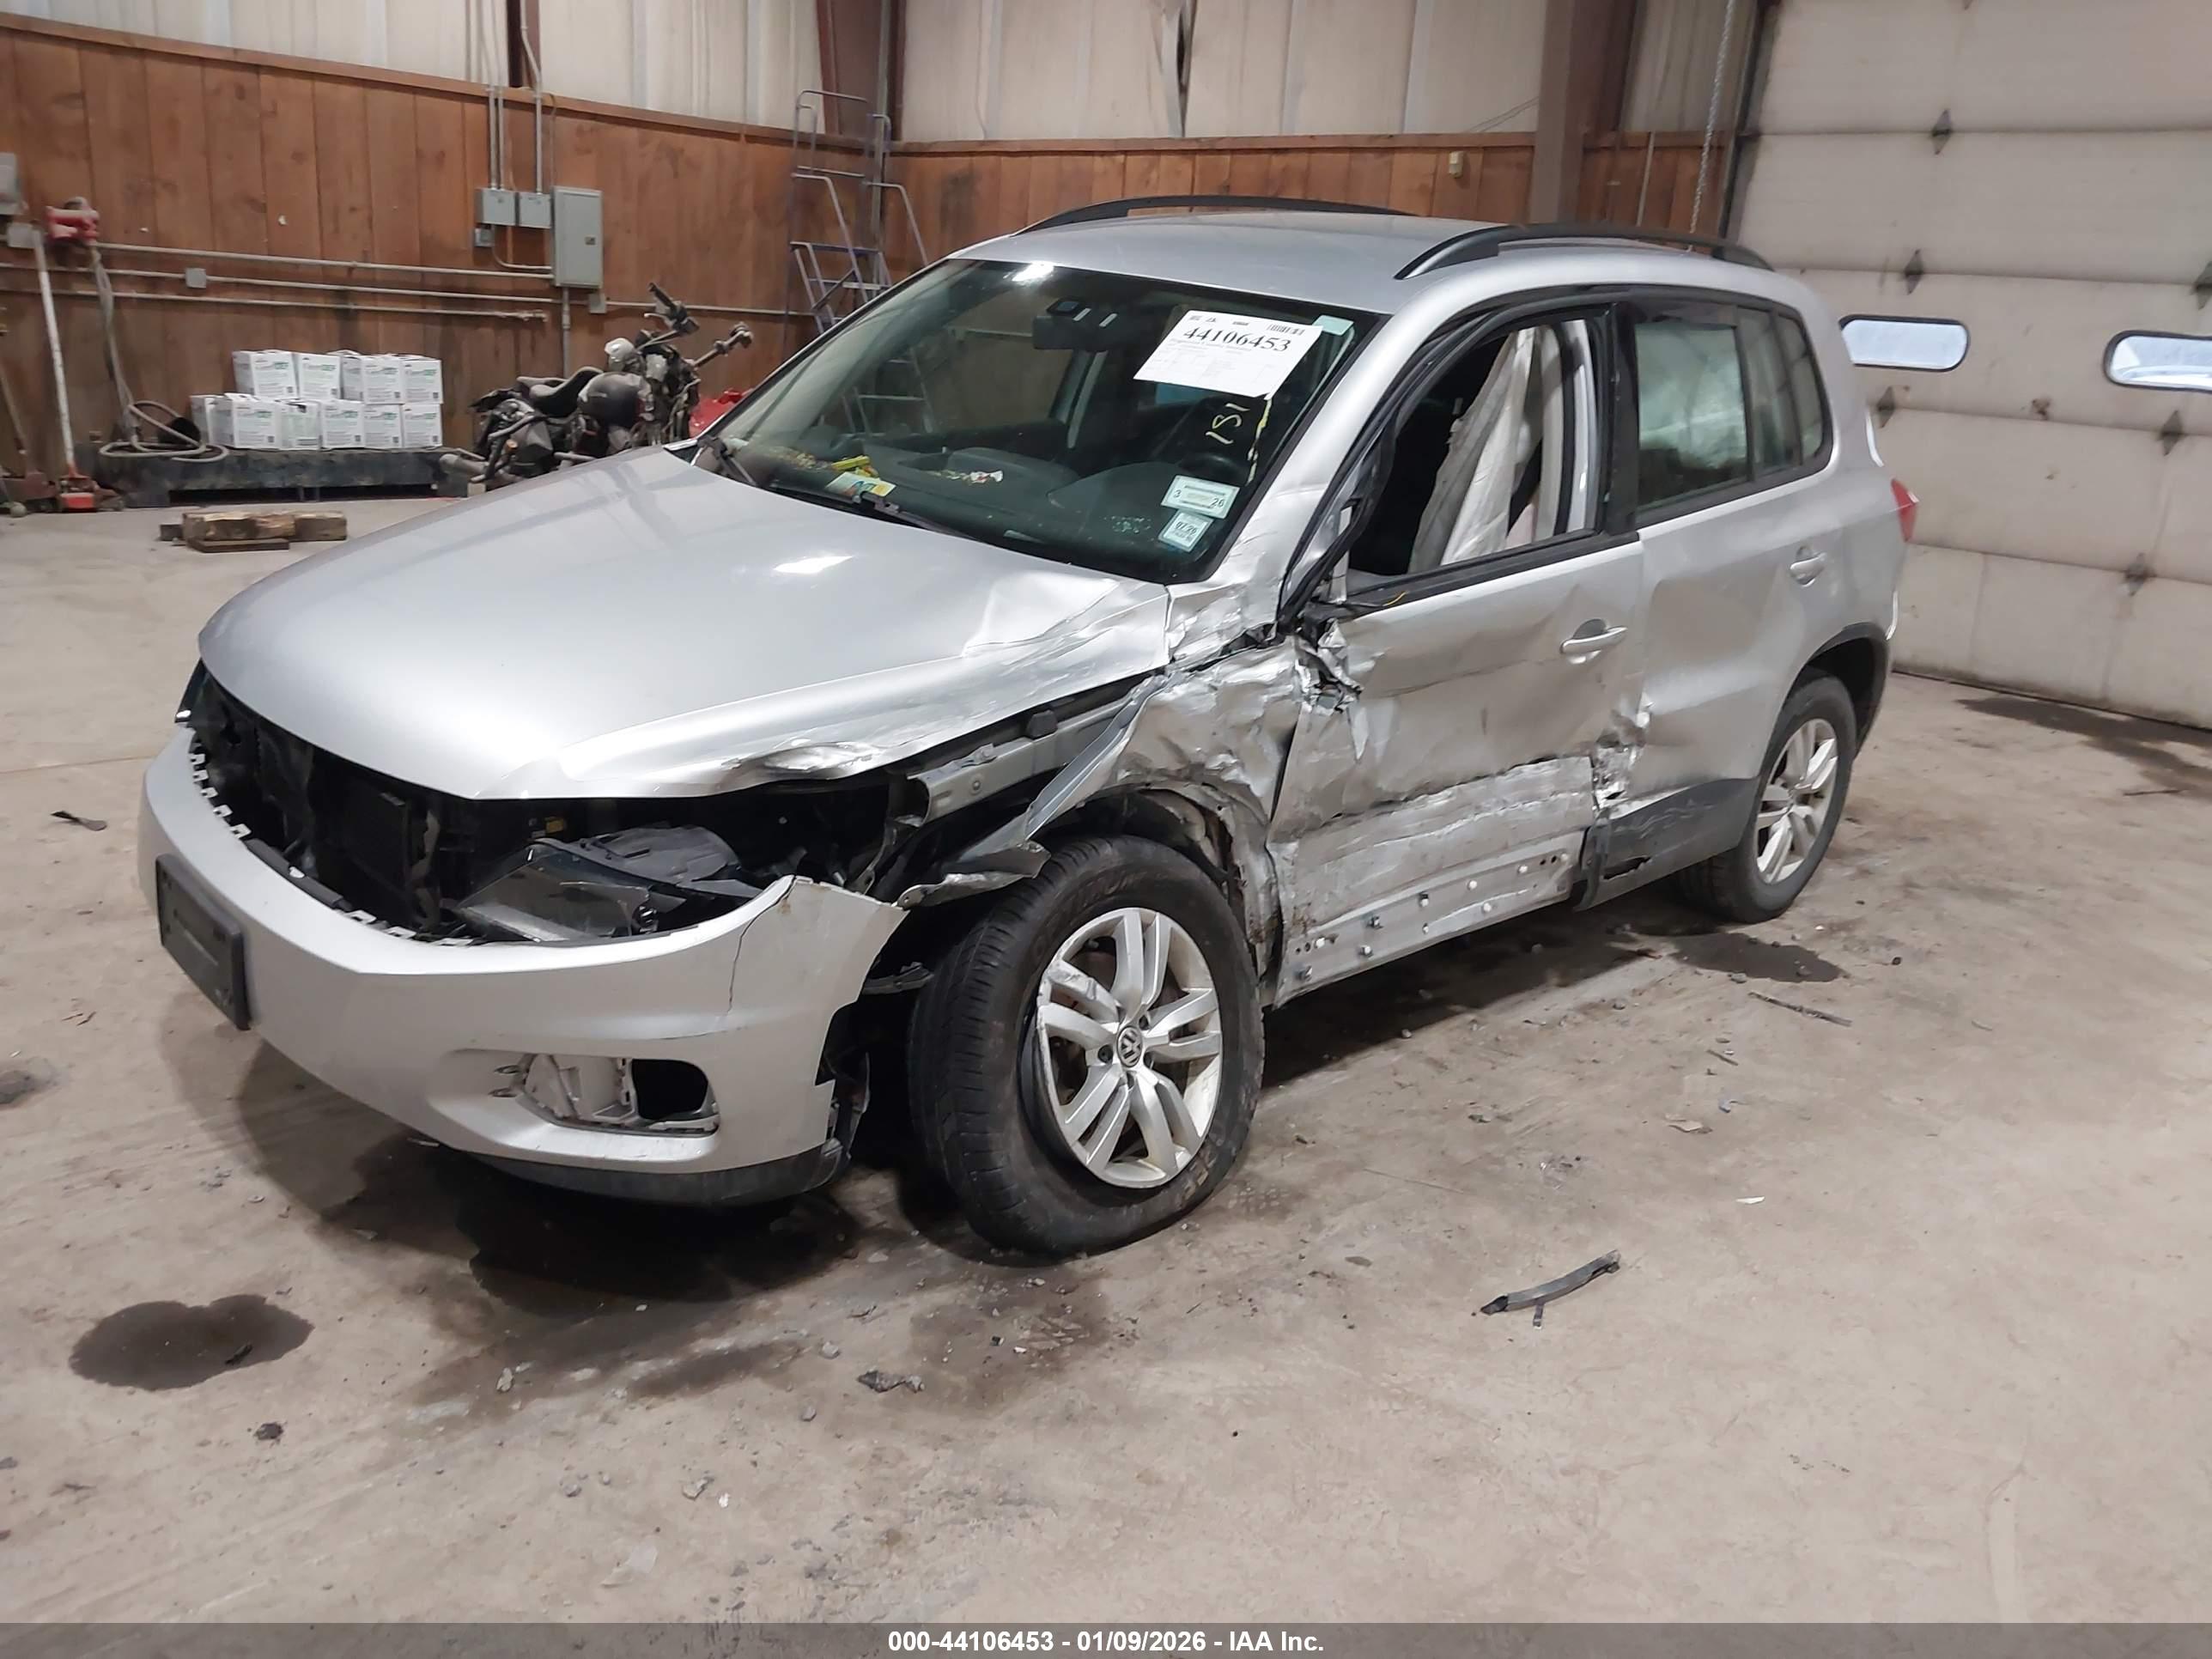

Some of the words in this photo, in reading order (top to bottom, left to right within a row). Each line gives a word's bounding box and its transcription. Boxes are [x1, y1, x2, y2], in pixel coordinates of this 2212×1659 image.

[1183, 326, 1291, 352] 44106453
[1174, 489, 1182, 498] 3
[1210, 497, 1224, 507] 26
